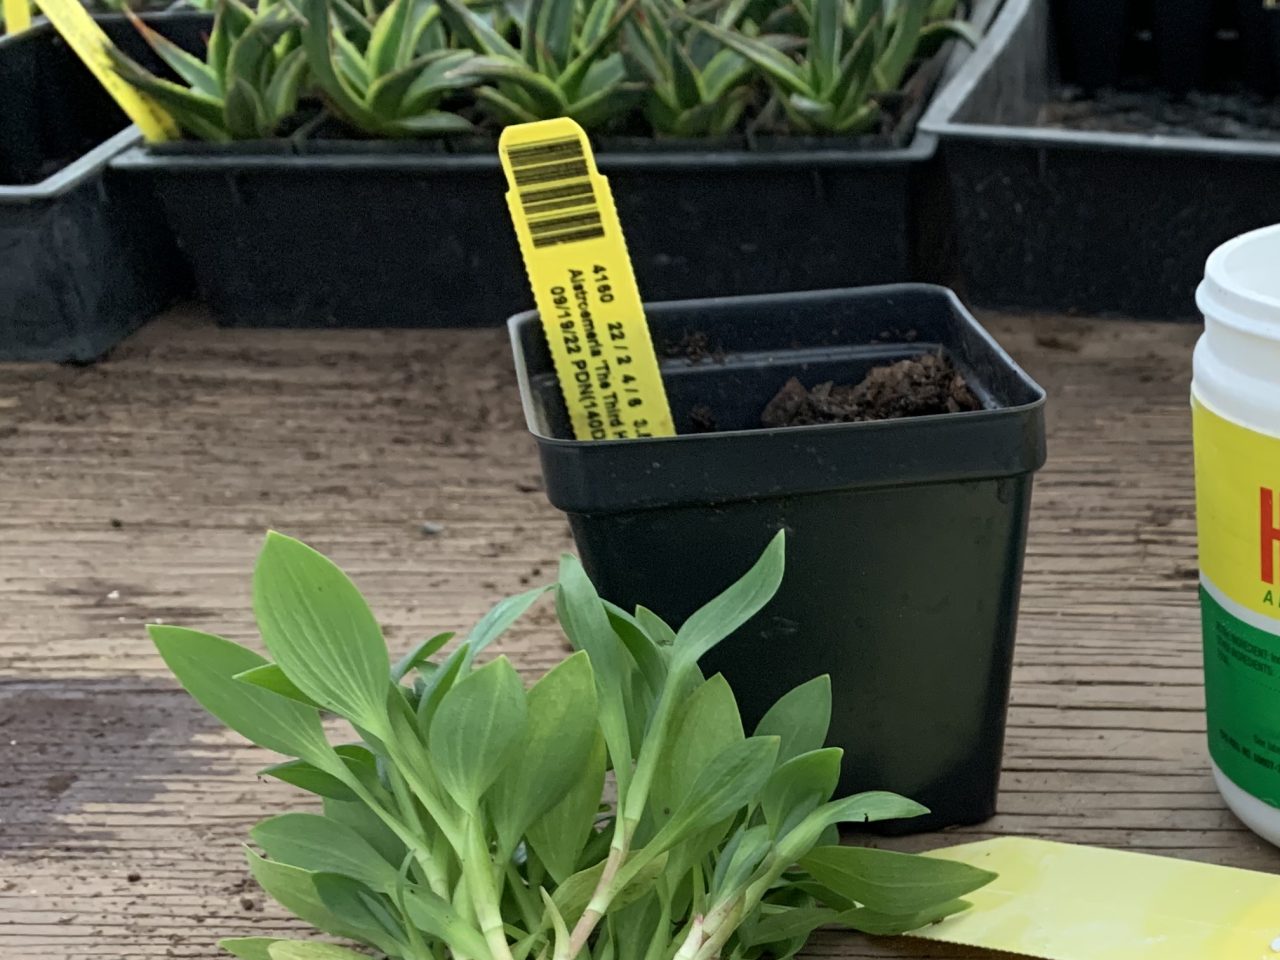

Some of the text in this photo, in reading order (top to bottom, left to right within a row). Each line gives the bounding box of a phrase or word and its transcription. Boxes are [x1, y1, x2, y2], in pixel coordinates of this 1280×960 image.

[549, 286, 582, 353] 09/19/22
[592, 264, 614, 303] 4160
[608, 321, 625, 341] 22
[1262, 590, 1275, 606] A
